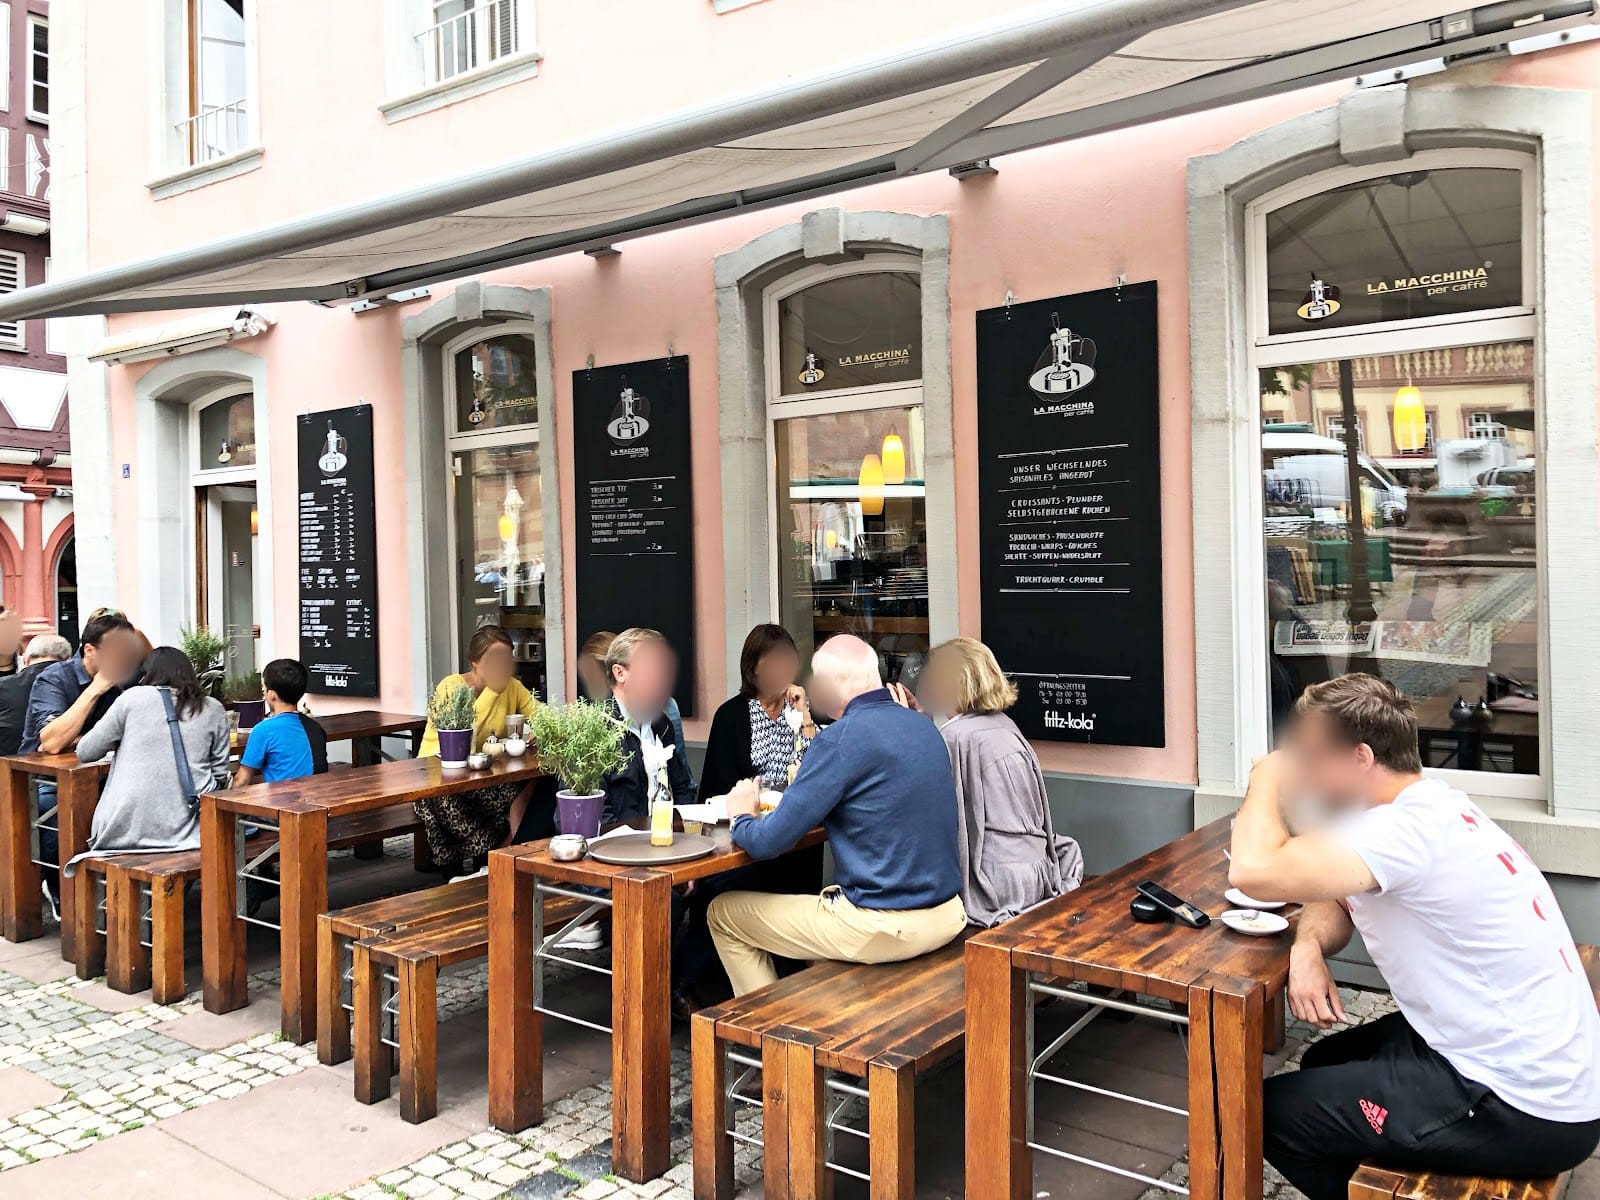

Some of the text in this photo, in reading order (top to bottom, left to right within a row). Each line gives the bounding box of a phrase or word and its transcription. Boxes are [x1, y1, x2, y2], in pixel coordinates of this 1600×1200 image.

[1367, 267, 1488, 292] LA MACCHINA
[1427, 286, 1450, 297] per
[839, 348, 909, 365] LA MACCHINA
[1034, 401, 1095, 414] LA MACCHINA
[1013, 459, 1108, 474] UNSER WECHSELNDES
[1059, 470, 1095, 480] ANGEBOT
[1011, 497, 1060, 508] CROISSANTS
[1007, 506, 1080, 518] SELBSTGEBACKENE
[1044, 709, 1094, 731] fritz-kola
[1358, 1098, 1384, 1135] adidas
